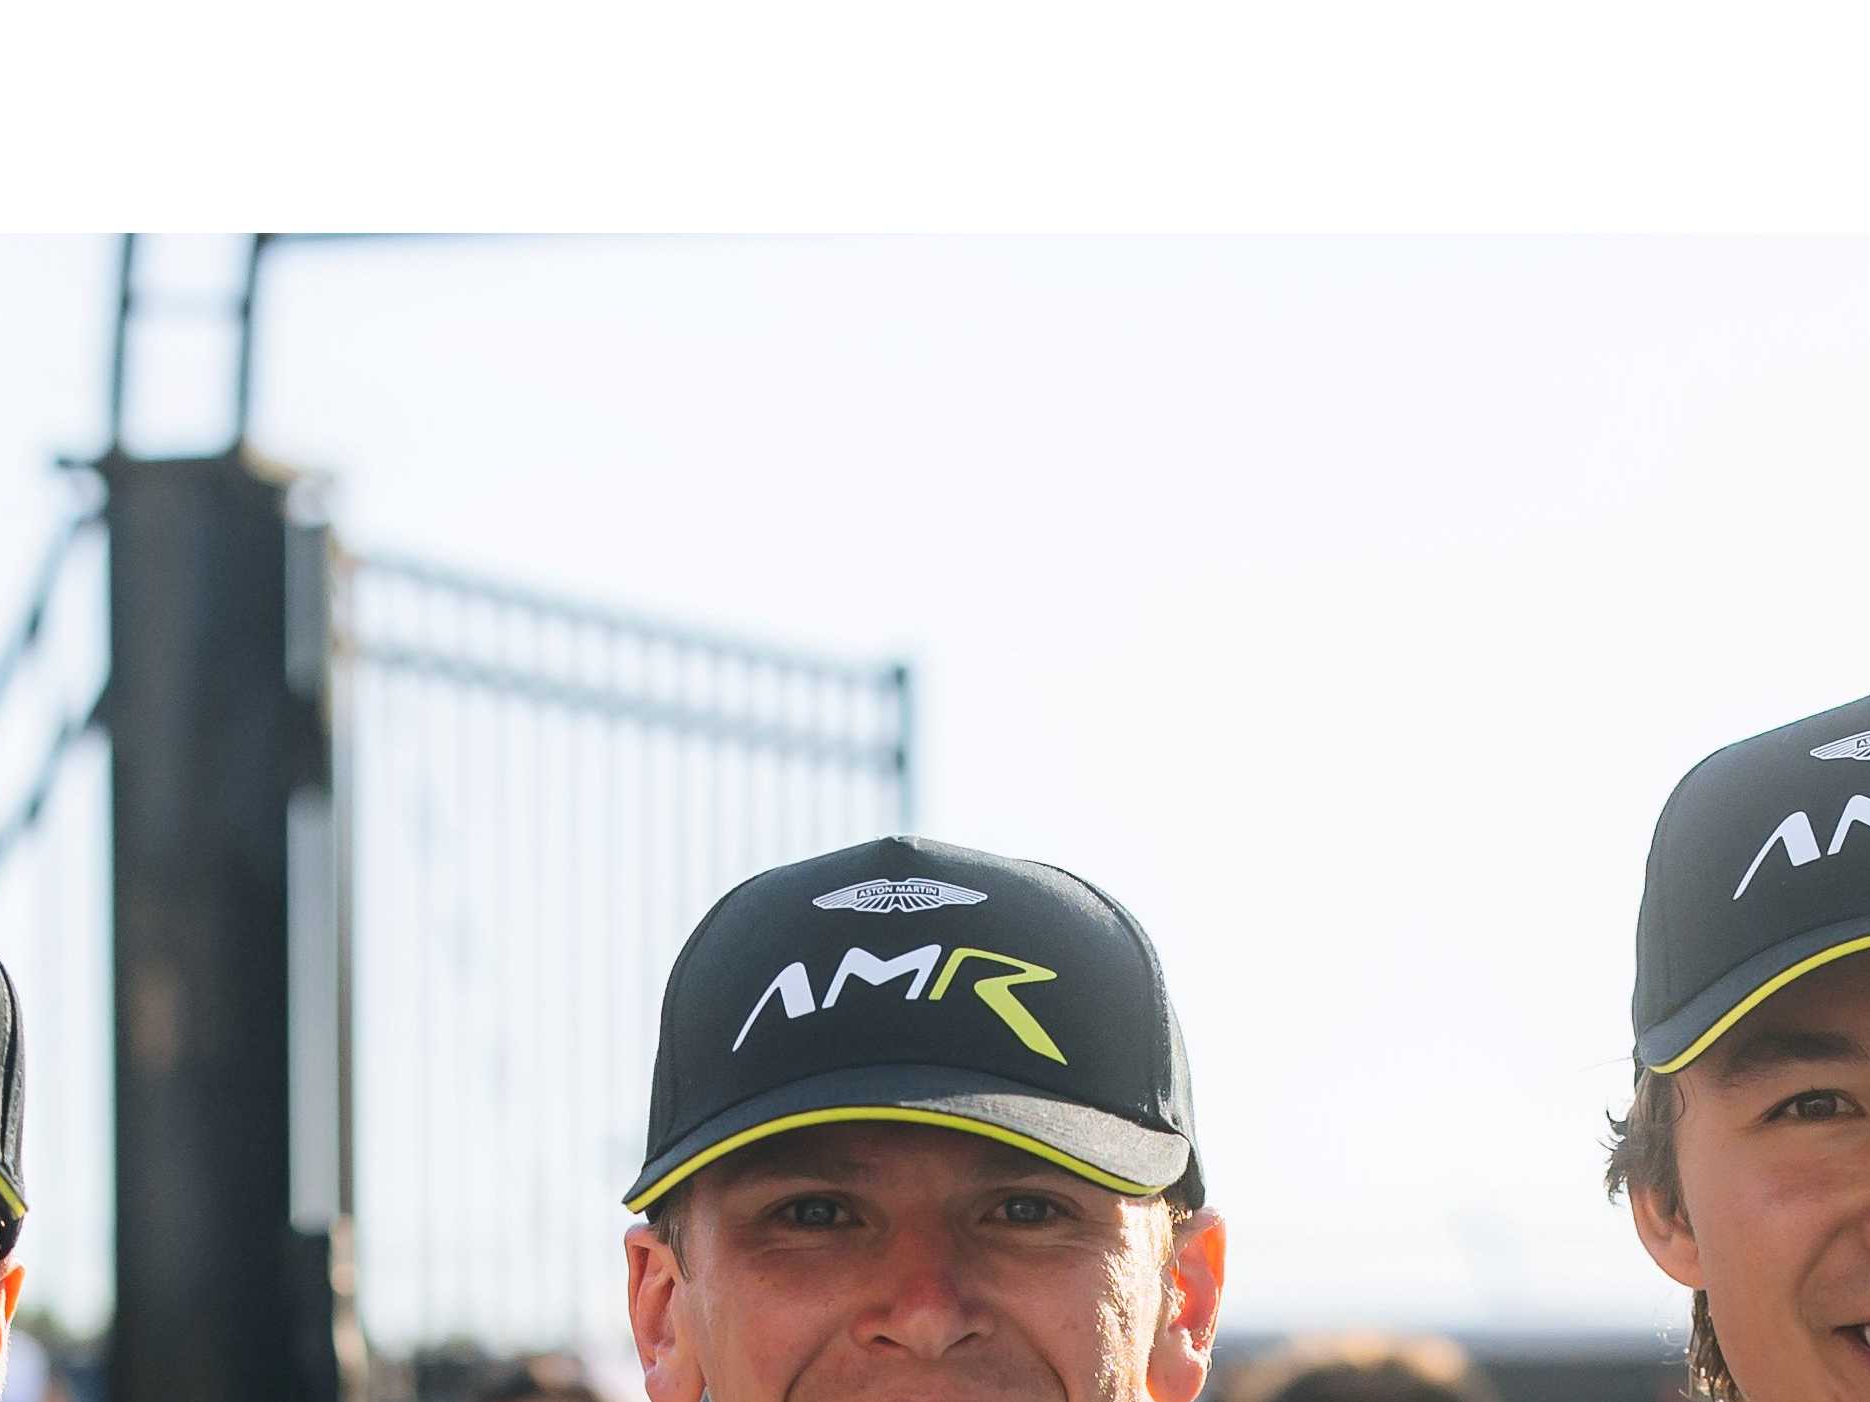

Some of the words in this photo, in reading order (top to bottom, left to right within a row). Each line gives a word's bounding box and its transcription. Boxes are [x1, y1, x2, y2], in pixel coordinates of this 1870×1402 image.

[857, 886, 894, 899] ASTON
[896, 885, 938, 896] MARTIN
[733, 944, 1068, 1066] AMR
